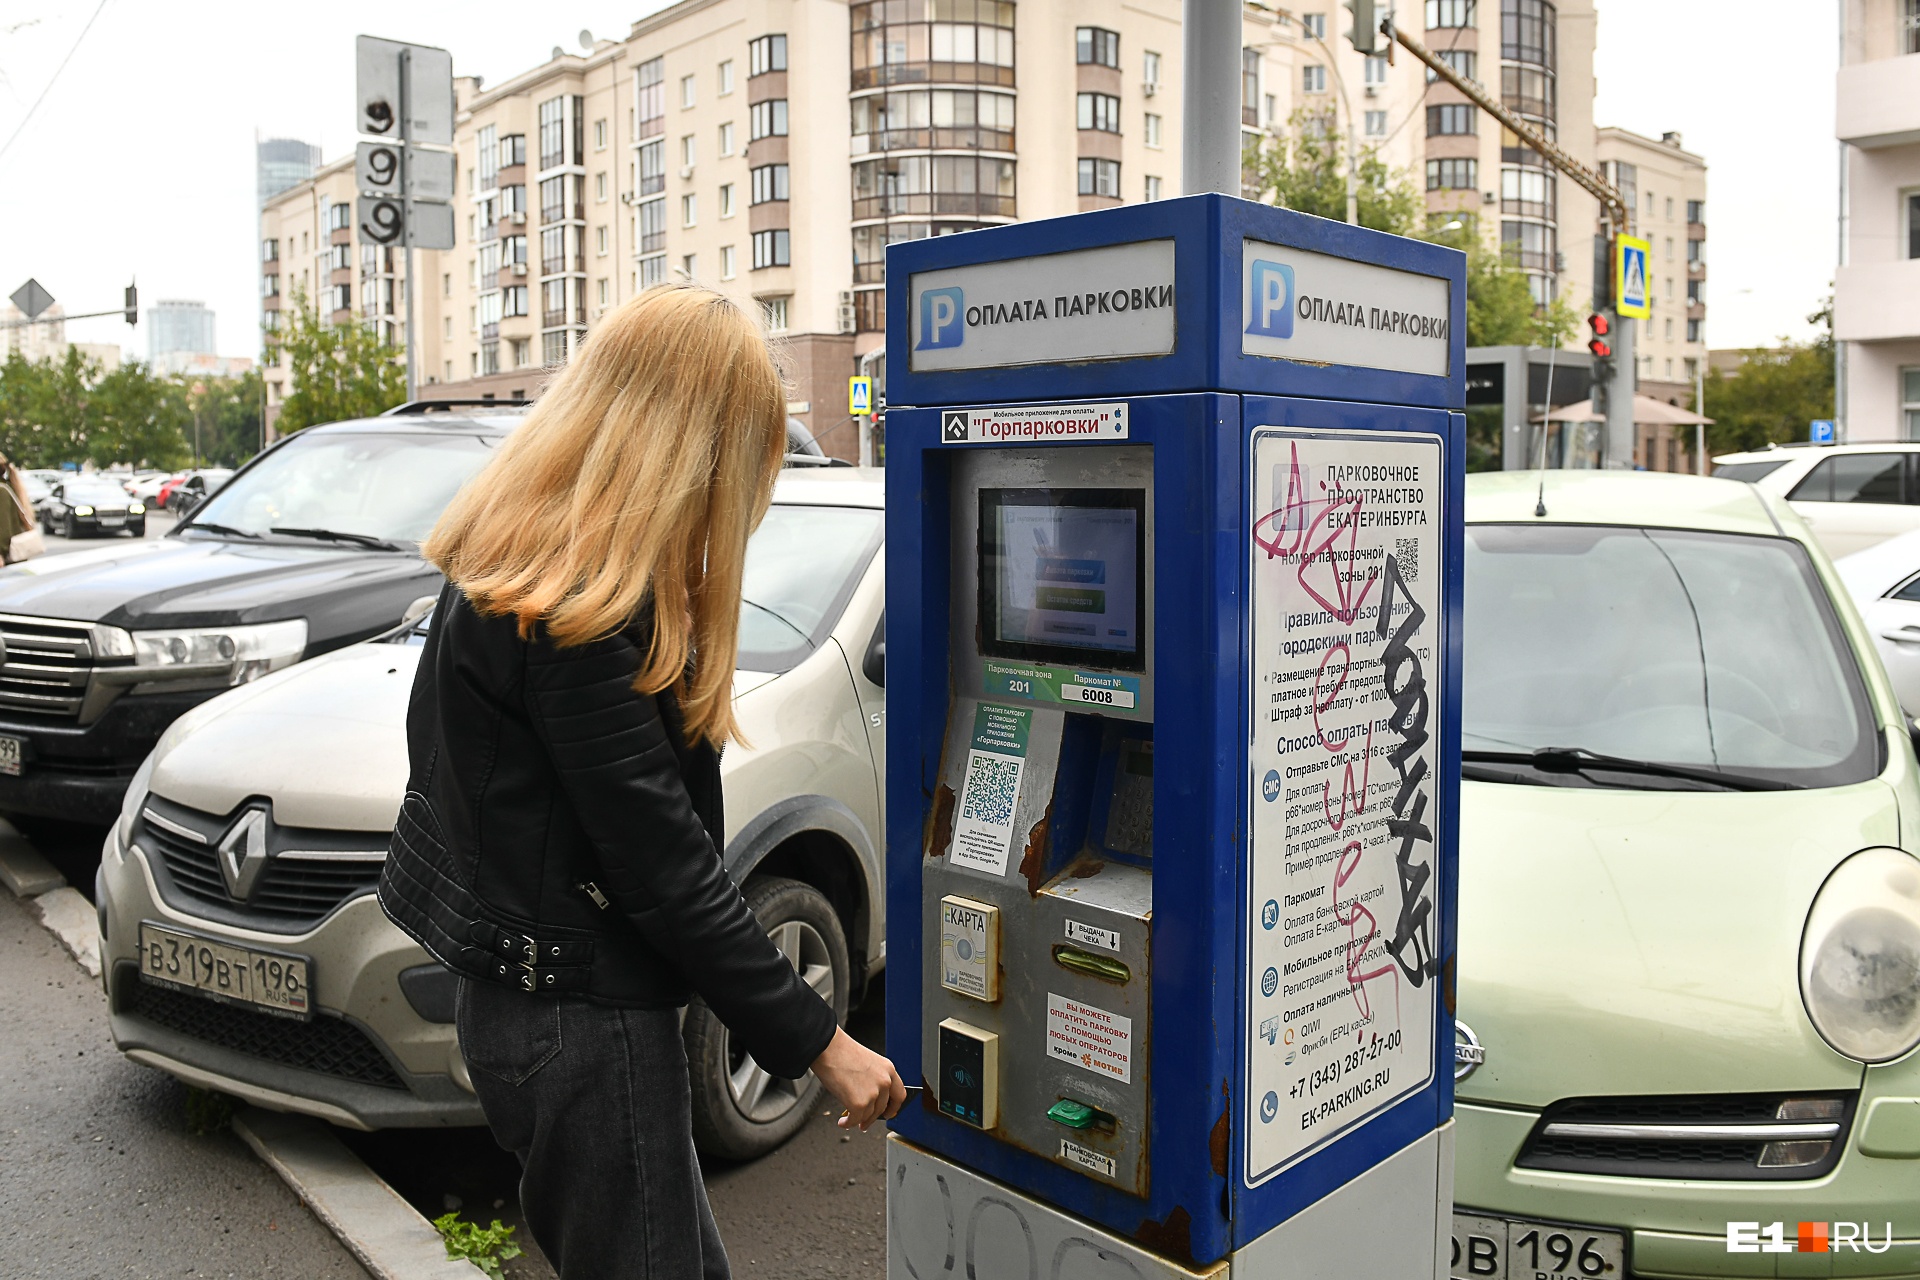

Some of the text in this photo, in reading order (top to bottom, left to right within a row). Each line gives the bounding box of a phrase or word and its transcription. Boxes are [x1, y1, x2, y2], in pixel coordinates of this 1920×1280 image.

[366, 148, 397, 185] 9
[362, 202, 401, 243] 9
[966, 284, 1173, 327] ОПЛАТА ПАРКОВКИ
[1299, 295, 1447, 340] ОПЛАТА ПАРКОВКИ
[993, 410, 1024, 418] Мобильное
[1025, 410, 1059, 418] приложение
[973, 413, 1109, 440] "Горпарковки"
[1328, 465, 1419, 482] ПАРКОВОЧНОЕ
[1328, 488, 1424, 505] ПРОСТРАНСТВО
[1328, 510, 1427, 529] ЕКАТЕРИНБУРГА
[1318, 544, 1384, 567] парковочной
[1339, 565, 1383, 583] зоны 201
[988, 664, 1034, 677] Парковочная
[1036, 671, 1052, 679] зона
[1074, 674, 1111, 687] Паркомат
[1271, 665, 1325, 685] Размещение
[1009, 680, 1029, 693] 201
[1082, 688, 1113, 704] 6008
[1271, 685, 1307, 704] платное
[1308, 685, 1314, 695] и
[1316, 680, 1348, 698] требует
[1271, 706, 1302, 723] Штраф
[1304, 706, 1313, 716] за
[1315, 696, 1353, 714] неоплату
[1359, 694, 1369, 704] от
[1371, 688, 1388, 702] 1000
[1277, 728, 1324, 755] Способ
[1327, 720, 1371, 743] оплаты
[1285, 759, 1329, 779] Отправьте
[1330, 753, 1348, 768] СМС
[1350, 752, 1360, 762] на
[1361, 747, 1378, 760] 3116
[1263, 780, 1280, 795] СМС
[1285, 788, 1300, 804] Для
[1285, 825, 1300, 840] Для
[1285, 844, 1300, 859] Для
[1285, 858, 1314, 876] Пример
[1363, 838, 1368, 850] 2
[1284, 884, 1326, 908] Паркомат
[1284, 884, 1385, 931] Оплата банковской картой
[1078, 924, 1105, 938] ВЫДАЧА
[1084, 934, 1100, 945] ЧЕКА
[1284, 929, 1314, 948] Оплата
[1283, 928, 1382, 977] Мобильное приложение
[150, 938, 299, 993] В319ВТ 196
[1283, 971, 1333, 998] Регистрация
[1335, 964, 1344, 976] на
[266, 989, 288, 1003] RUS
[1283, 980, 1363, 1023] Оплата наличными
[1050, 1008, 1128, 1040] ОПЛАТИТЬ ПАРКОВКУ
[1066, 1002, 1111, 1024] ВЫ МОЖЕТЕ
[1064, 1024, 1112, 1046] С ПОМОЩЬЮ
[1301, 1018, 1321, 1038] QIWI
[1049, 1029, 1128, 1063] ЛЮБЫХ ОПЕРАТОРОВ
[1053, 1045, 1078, 1059] кроме
[1301, 1034, 1328, 1056] Фрисби
[1289, 1029, 1401, 1100] +7 (343) 287-27-00
[1301, 1068, 1390, 1131] EK-PARKING.RU
[1069, 1144, 1107, 1164] БАНКОВСКАЯ
[1078, 1156, 1097, 1168] КАРТА
[1516, 1230, 1606, 1276] 196
